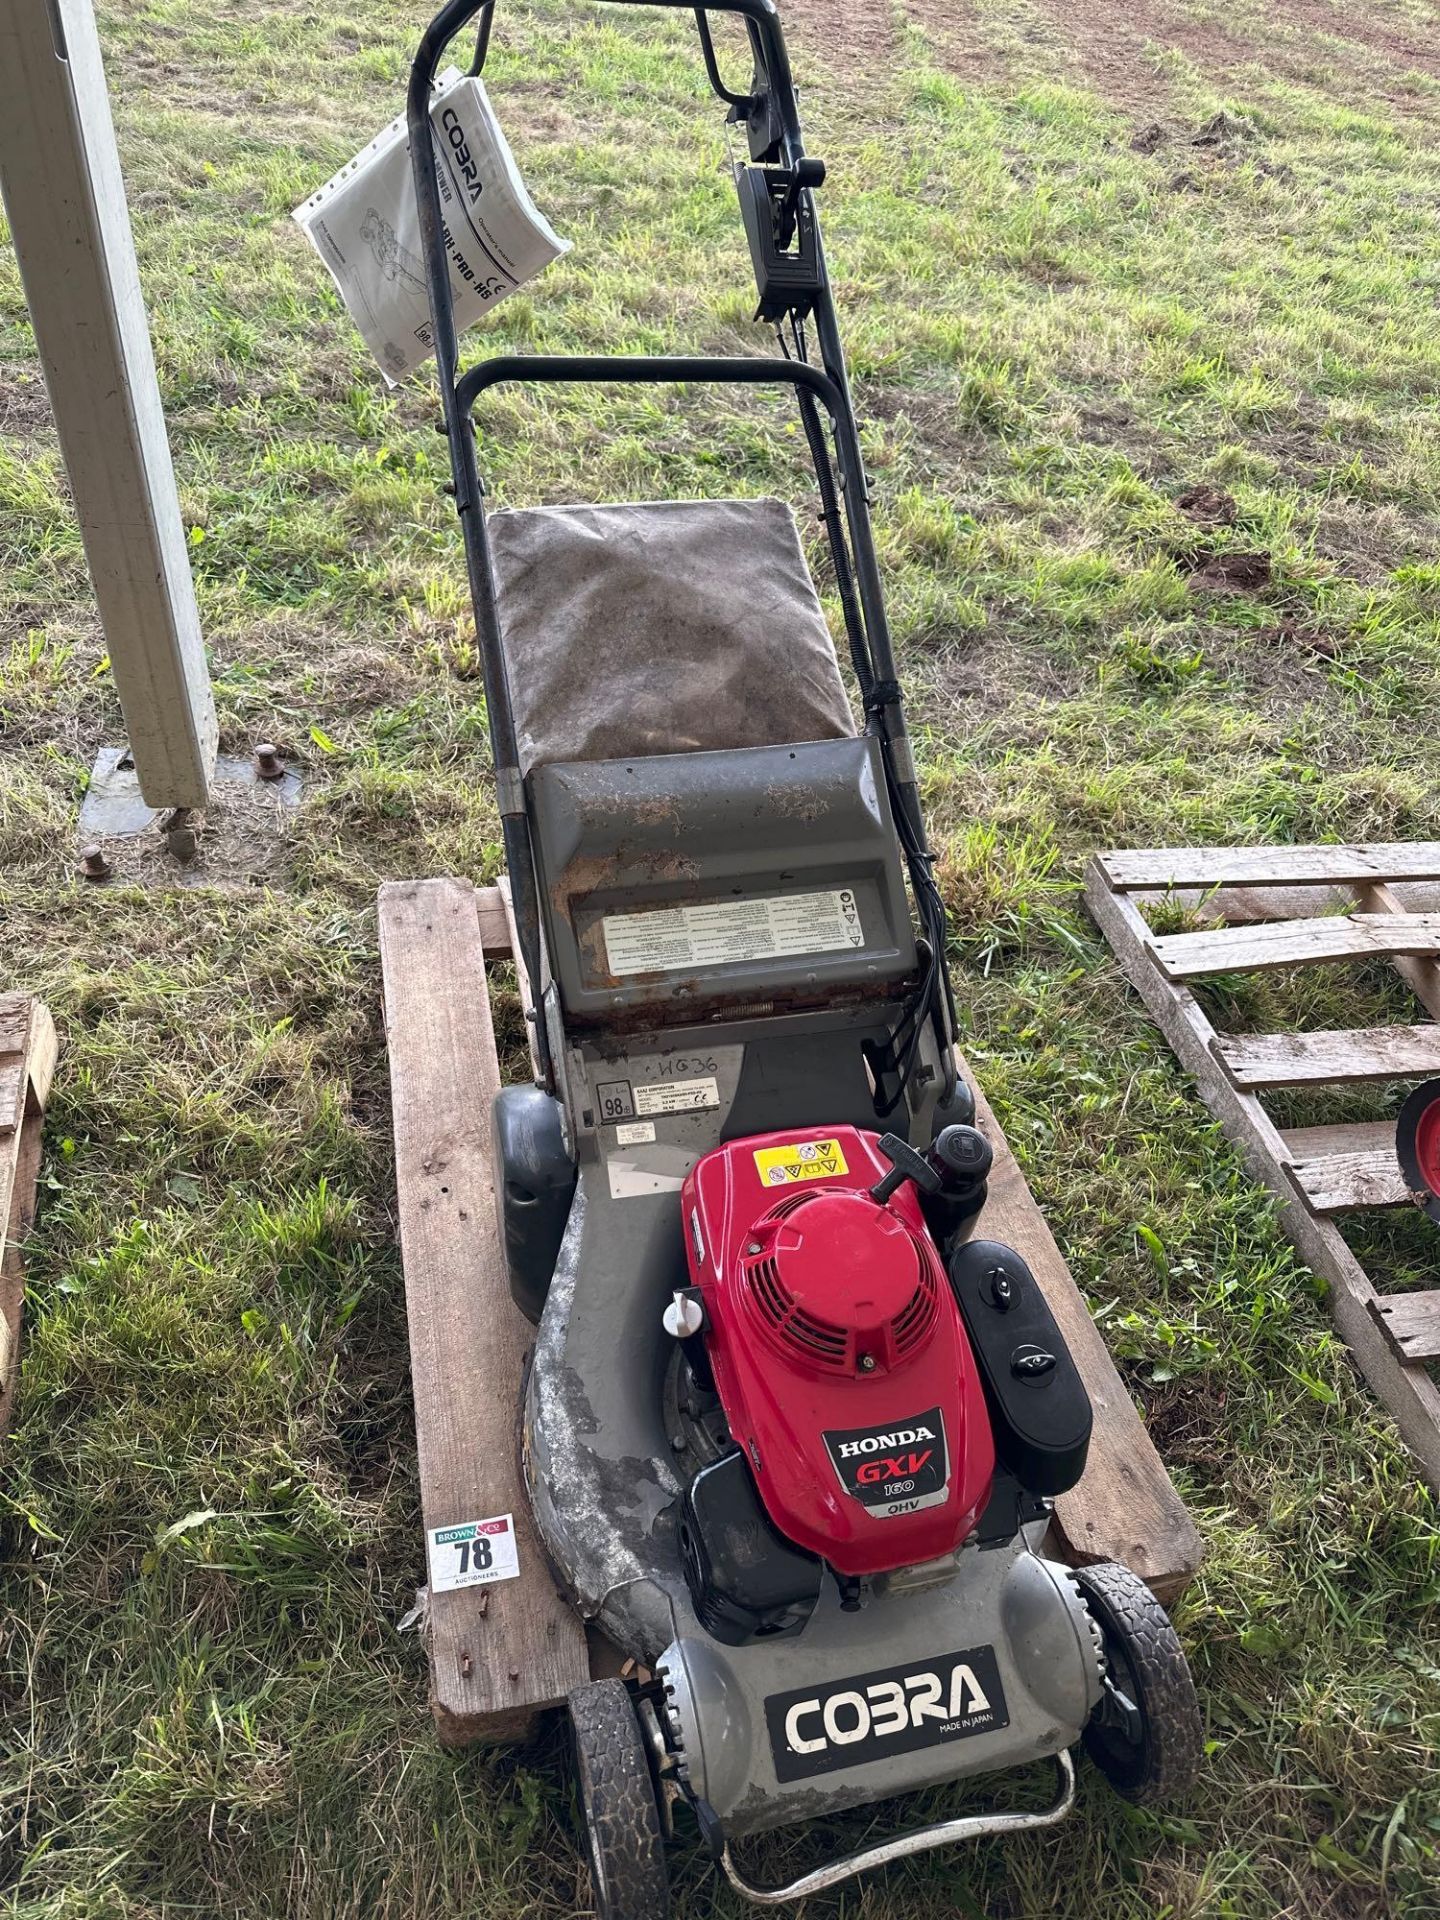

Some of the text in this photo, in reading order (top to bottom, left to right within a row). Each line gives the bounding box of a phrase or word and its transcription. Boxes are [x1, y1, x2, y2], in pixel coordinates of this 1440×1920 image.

[442, 108, 482, 204] COBRA
[478, 218, 516, 268] Operator's manual
[418, 330, 432, 342] 98
[605, 1098, 623, 1116] 98
[838, 1426, 936, 1458] HONDA
[856, 1450, 934, 1484] GXV
[884, 1480, 914, 1496] 160
[888, 1500, 920, 1514] OHV
[454, 1538, 493, 1574] 78
[455, 1572, 499, 1584] AUCTIONEERS
[785, 1664, 991, 1754] COBRA
[939, 1713, 994, 1734] MADE IN JAPAN
